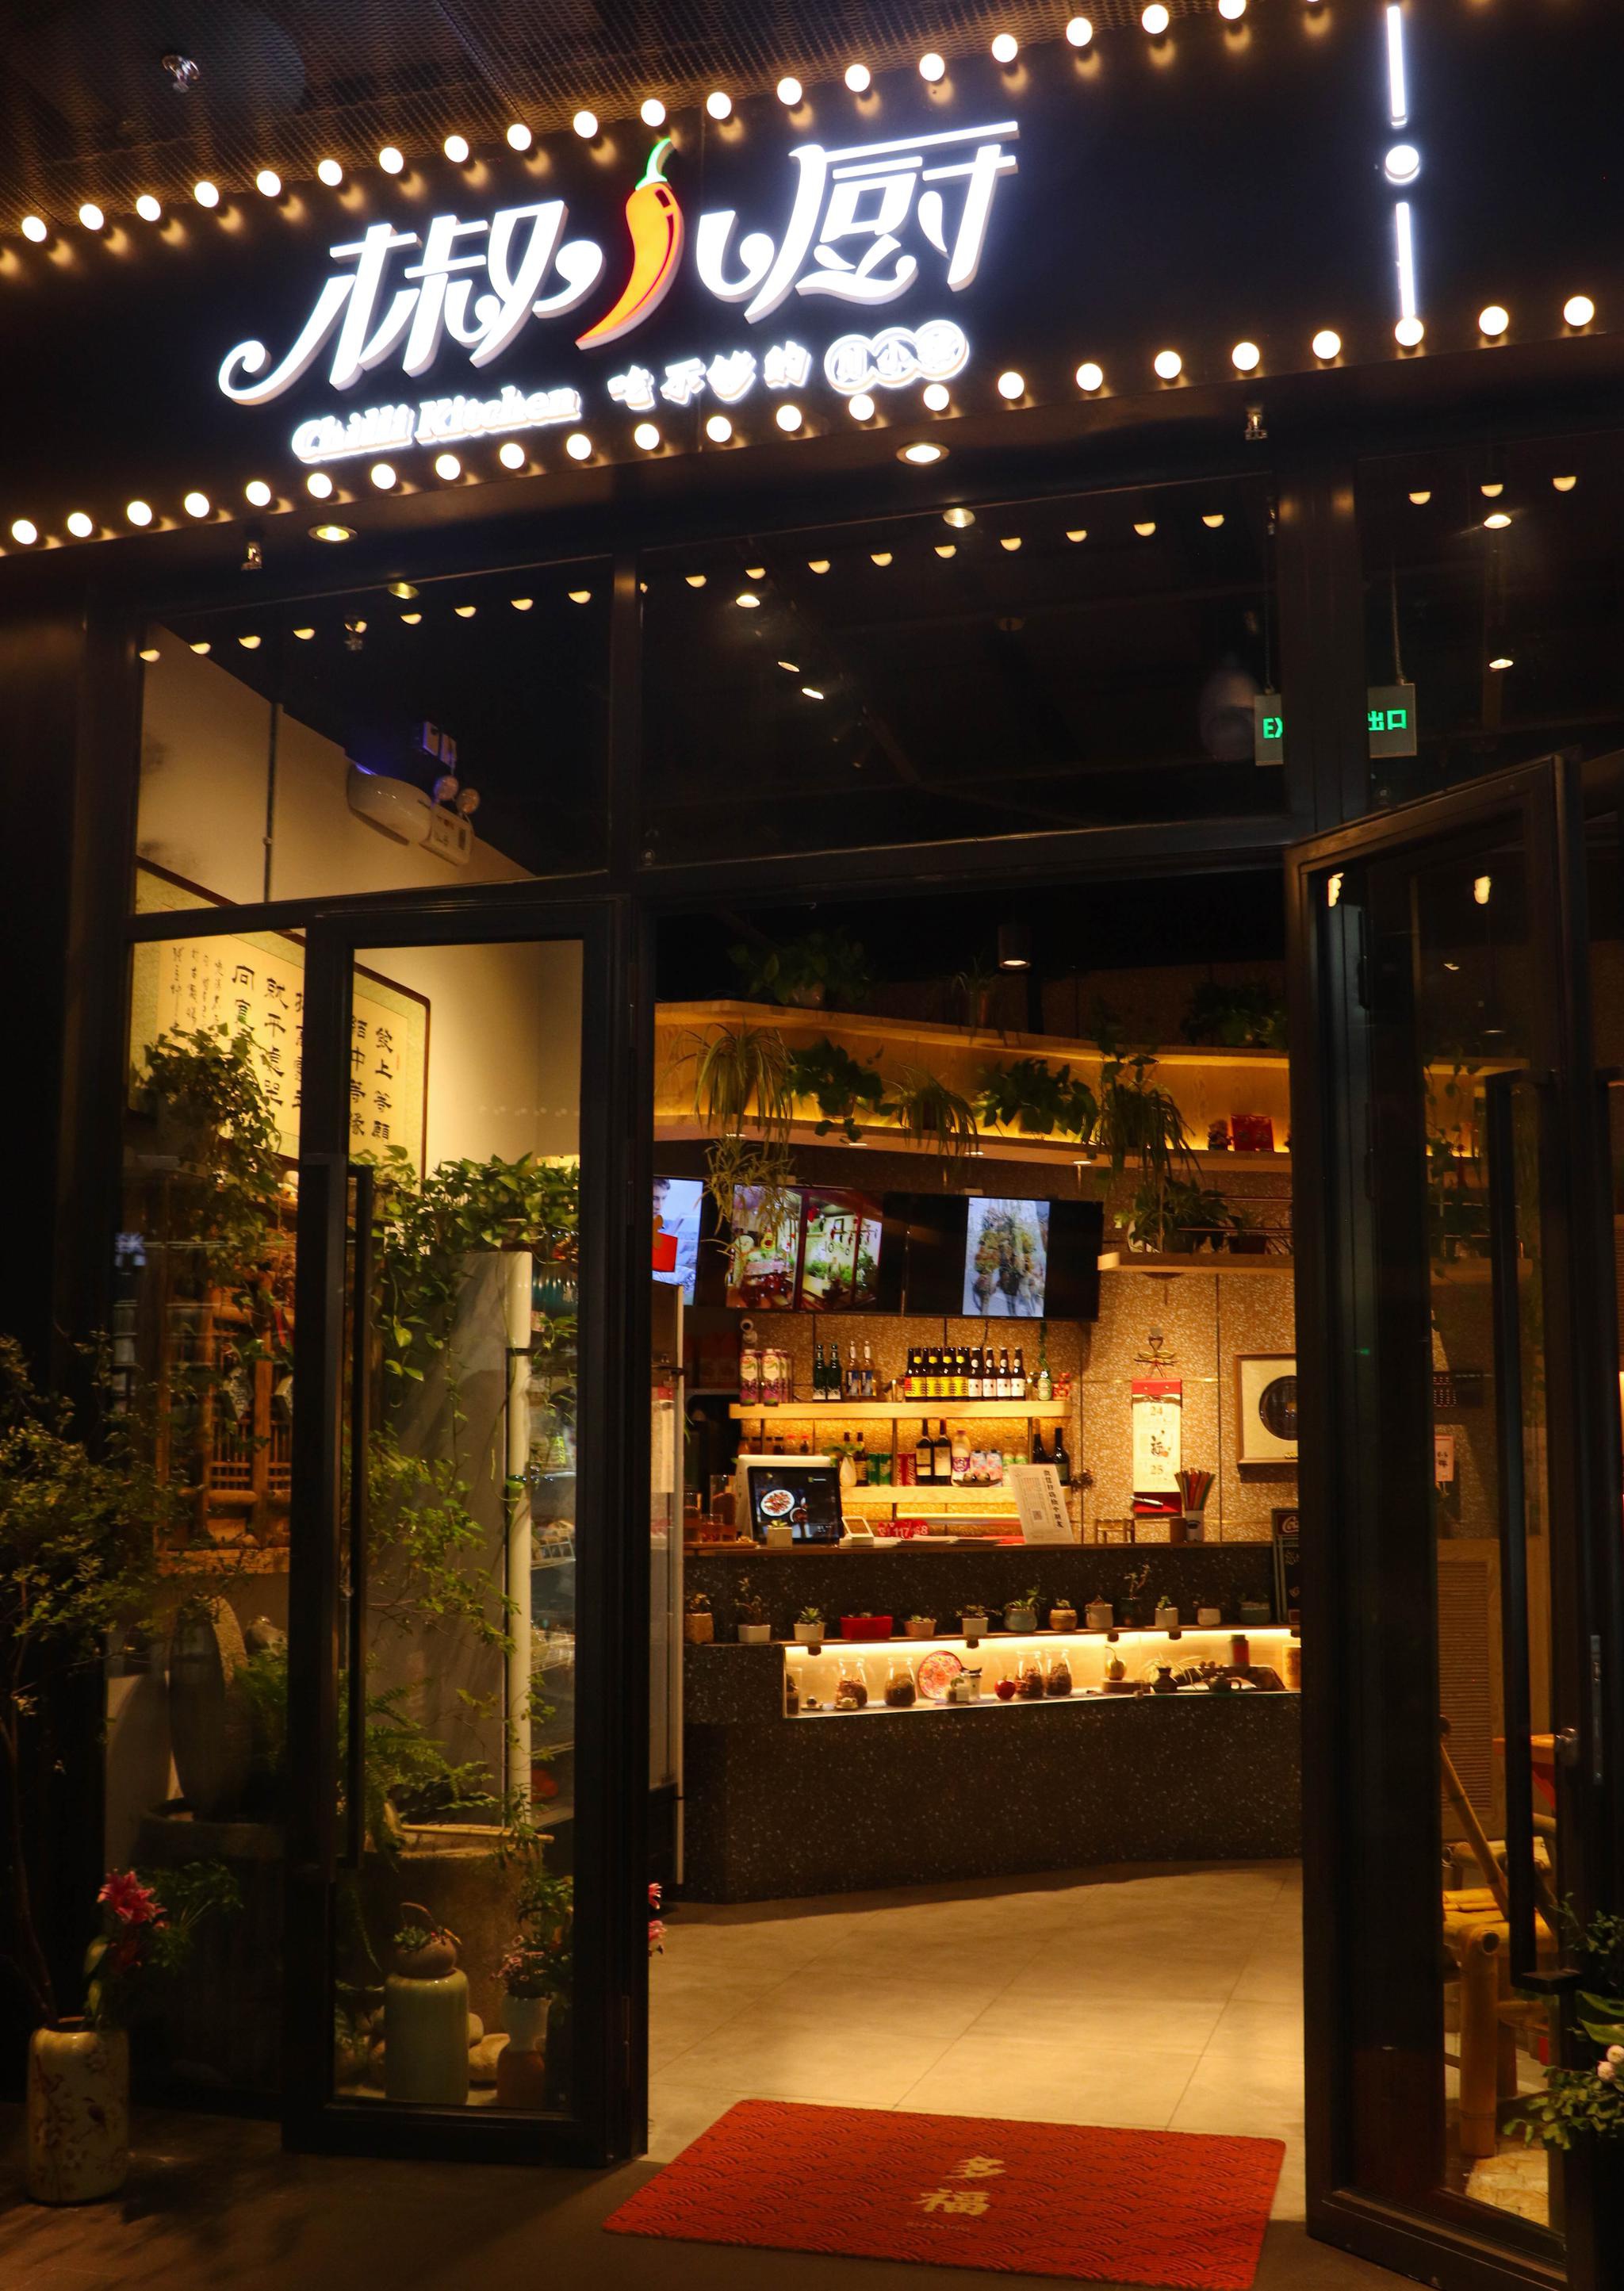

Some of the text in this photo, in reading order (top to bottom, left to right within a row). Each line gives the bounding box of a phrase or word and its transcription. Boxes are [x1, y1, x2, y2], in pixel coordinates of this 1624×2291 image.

[415, 385, 582, 445] Kitchen
[1367, 709, 1408, 731] 出口
[912, 2155, 1007, 2216] 多福
